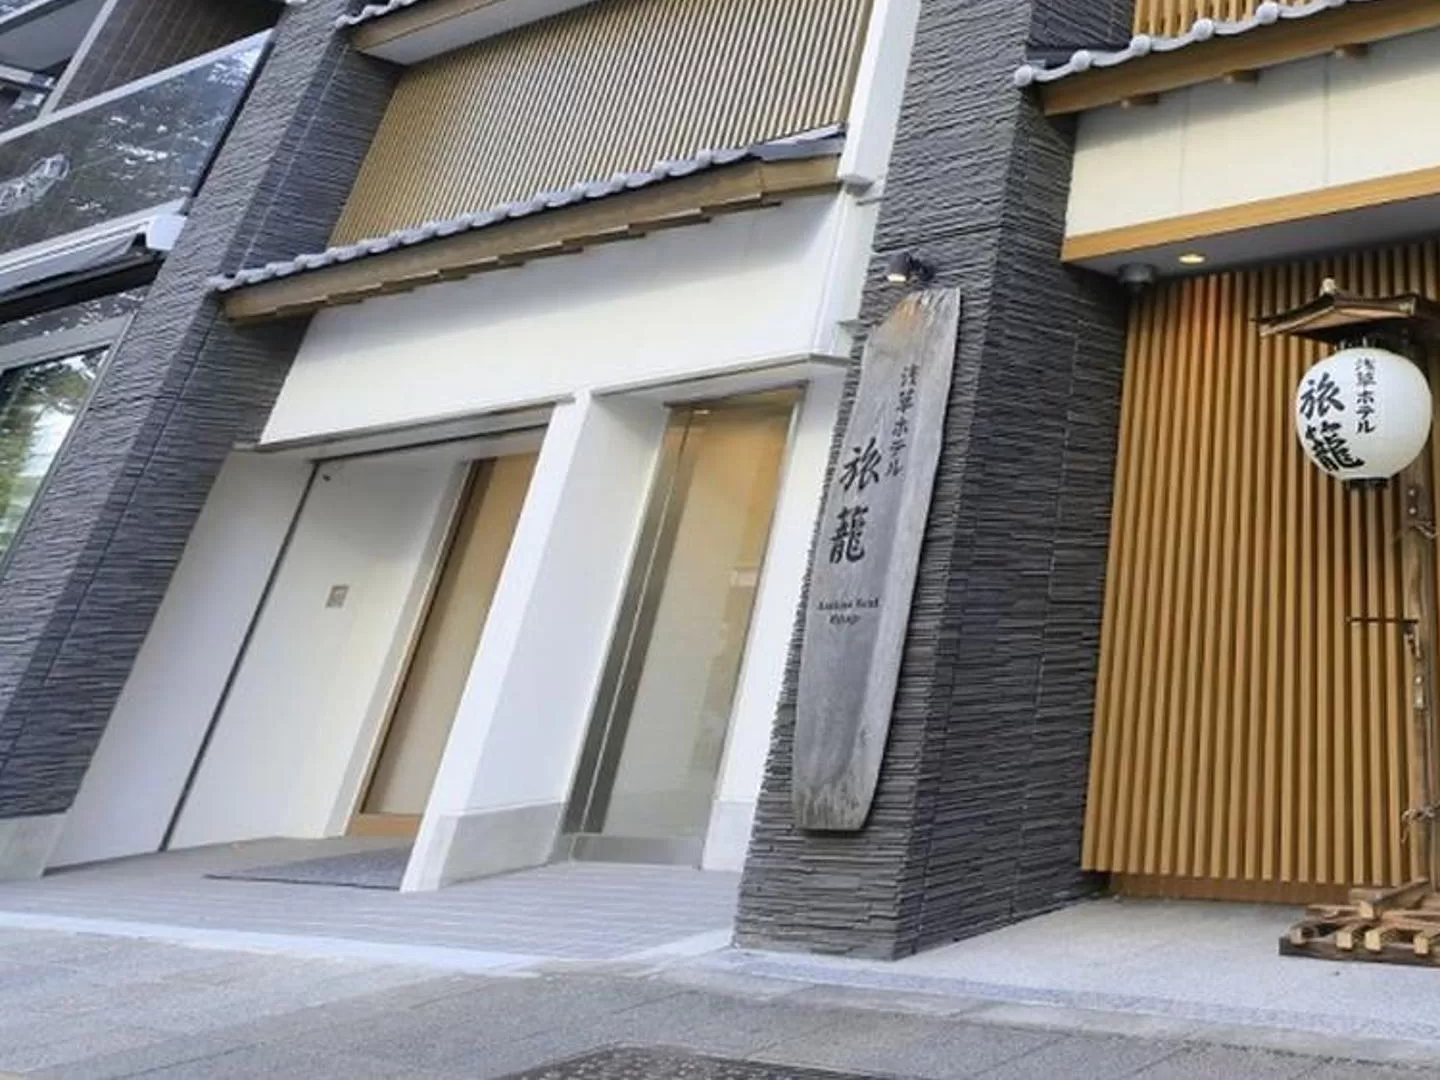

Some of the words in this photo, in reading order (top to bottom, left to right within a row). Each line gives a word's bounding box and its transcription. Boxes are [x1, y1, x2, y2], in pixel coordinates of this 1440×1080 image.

[1300, 372, 1365, 472] 旅籠
[1355, 358, 1376, 434] 浅草ホテル
[829, 436, 882, 564] 旅籠
